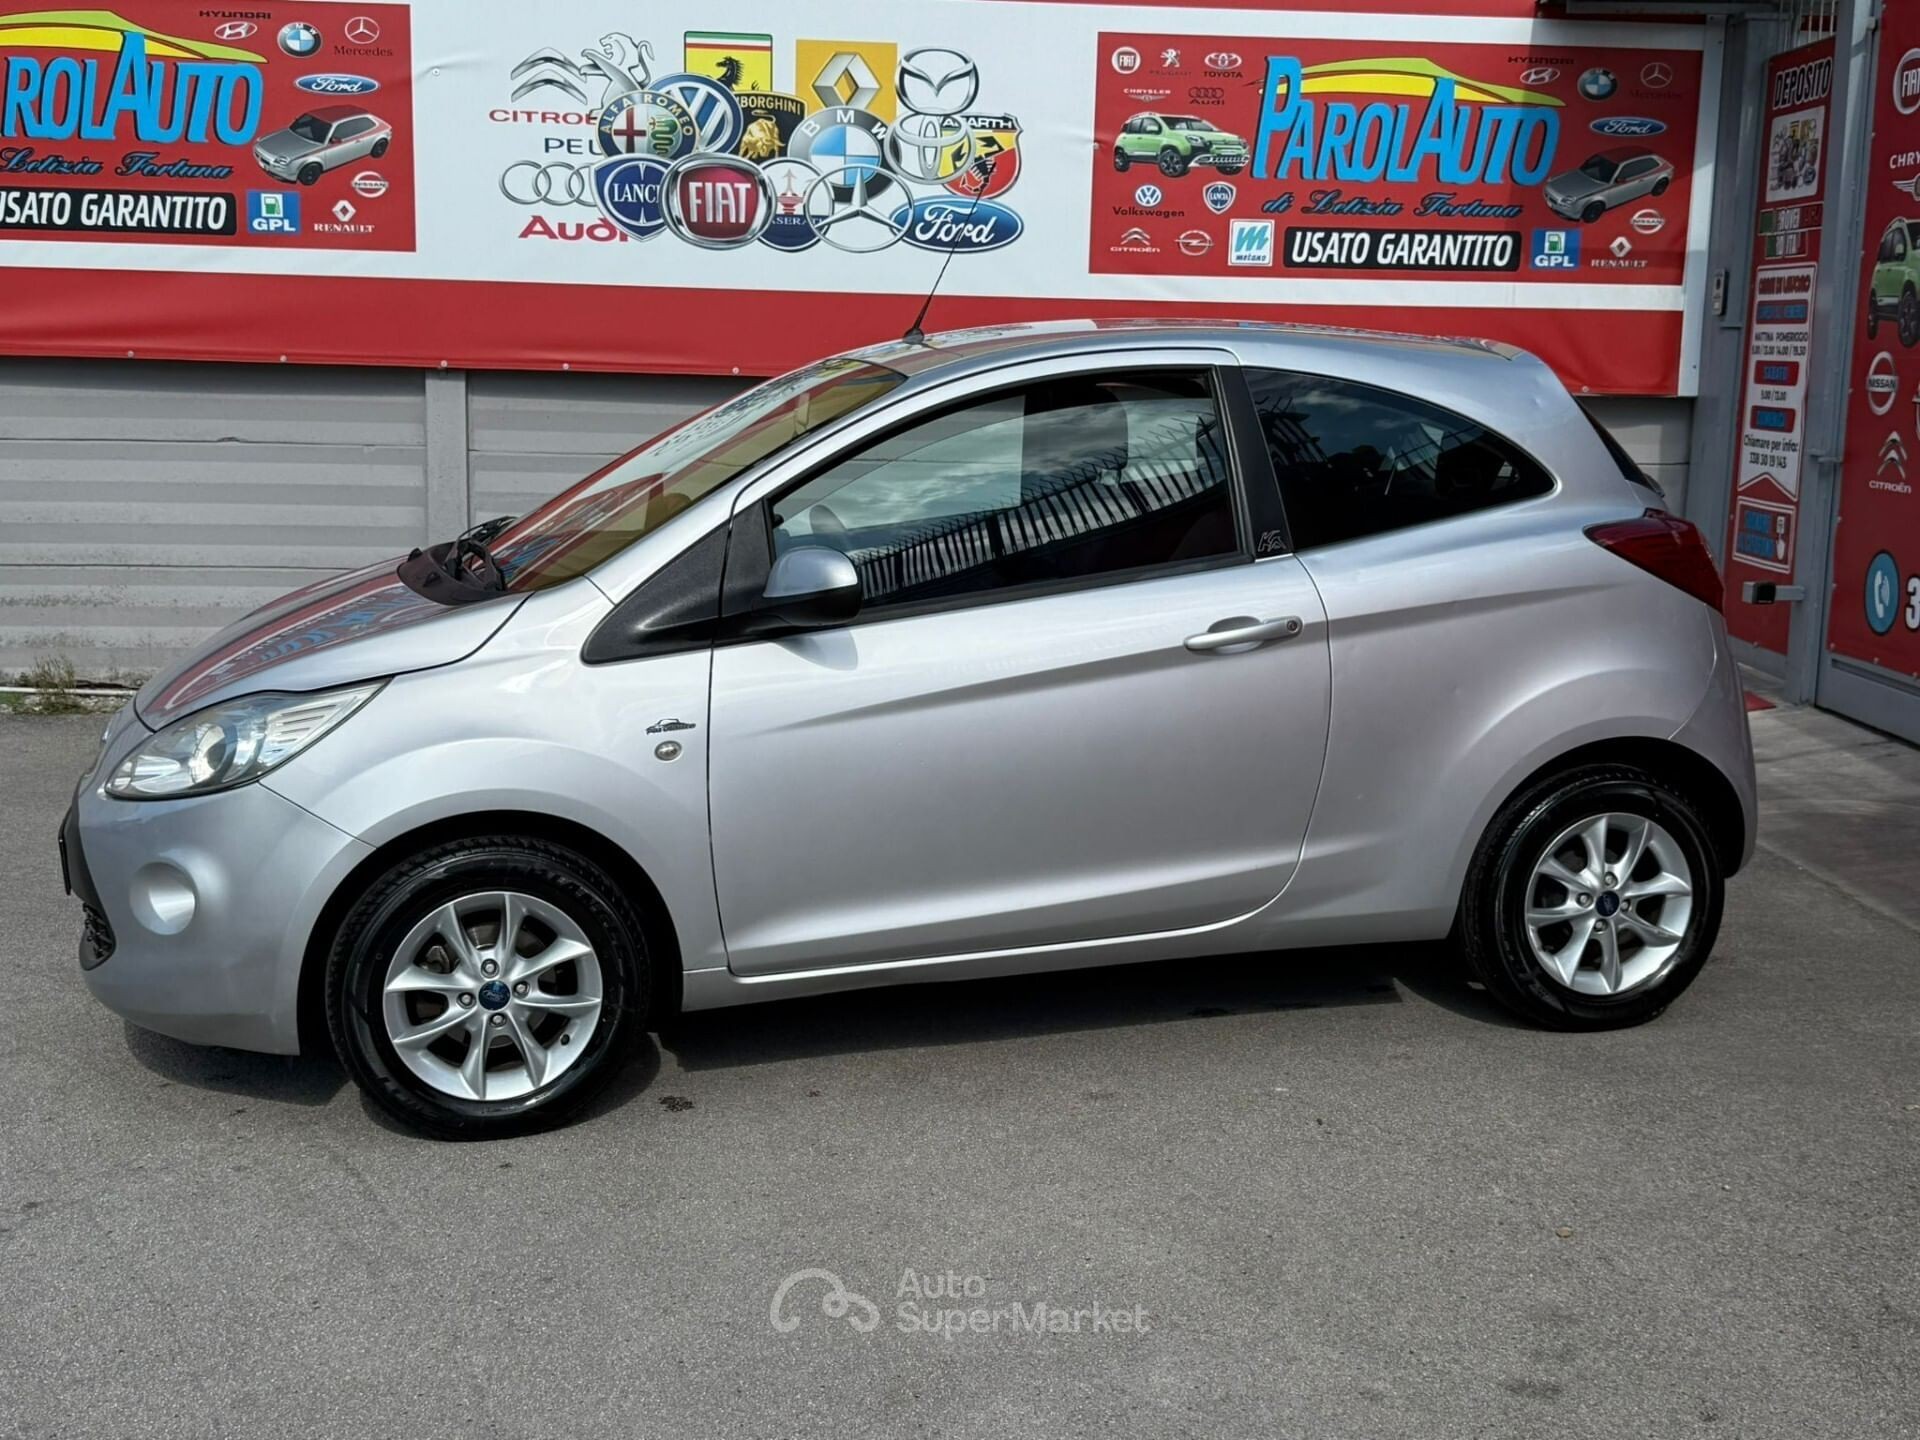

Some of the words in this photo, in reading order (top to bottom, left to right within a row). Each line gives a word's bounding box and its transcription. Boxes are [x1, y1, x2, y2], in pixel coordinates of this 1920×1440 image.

[199, 10, 271, 19] HYUNDAI
[334, 46, 393, 57] Mercedes
[1119, 54, 1135, 67] FIAT
[1508, 56, 1574, 65] HYUNDAI
[1203, 71, 1243, 79] TOYOTA
[312, 77, 362, 92] Ford
[1773, 57, 1832, 110] DEPOSITO
[1123, 87, 1171, 95] CHRYSLER
[738, 95, 801, 115] BORGHINI
[1189, 98, 1225, 106] Audi
[599, 97, 633, 134] ALFA
[643, 93, 694, 136] ROMEO
[1604, 118, 1651, 135] Ford
[116, 149, 234, 179] Fortuna
[687, 181, 752, 224] FIAT
[1209, 192, 1229, 201] LANCIA
[1301, 189, 1403, 217] Letizia
[1413, 192, 1524, 218] Fortuna
[80, 192, 228, 230] GARANTITO
[1112, 206, 1185, 219] Volkswagen
[252, 218, 296, 232] GPL
[313, 223, 375, 233] RENAULT
[914, 204, 998, 243] Ford
[1291, 231, 1370, 264] USATO
[1377, 233, 1513, 268] GARANTITO
[1535, 255, 1574, 268] GPL
[1590, 259, 1648, 269] RENAULT
[1868, 377, 1897, 389] NISSAN
